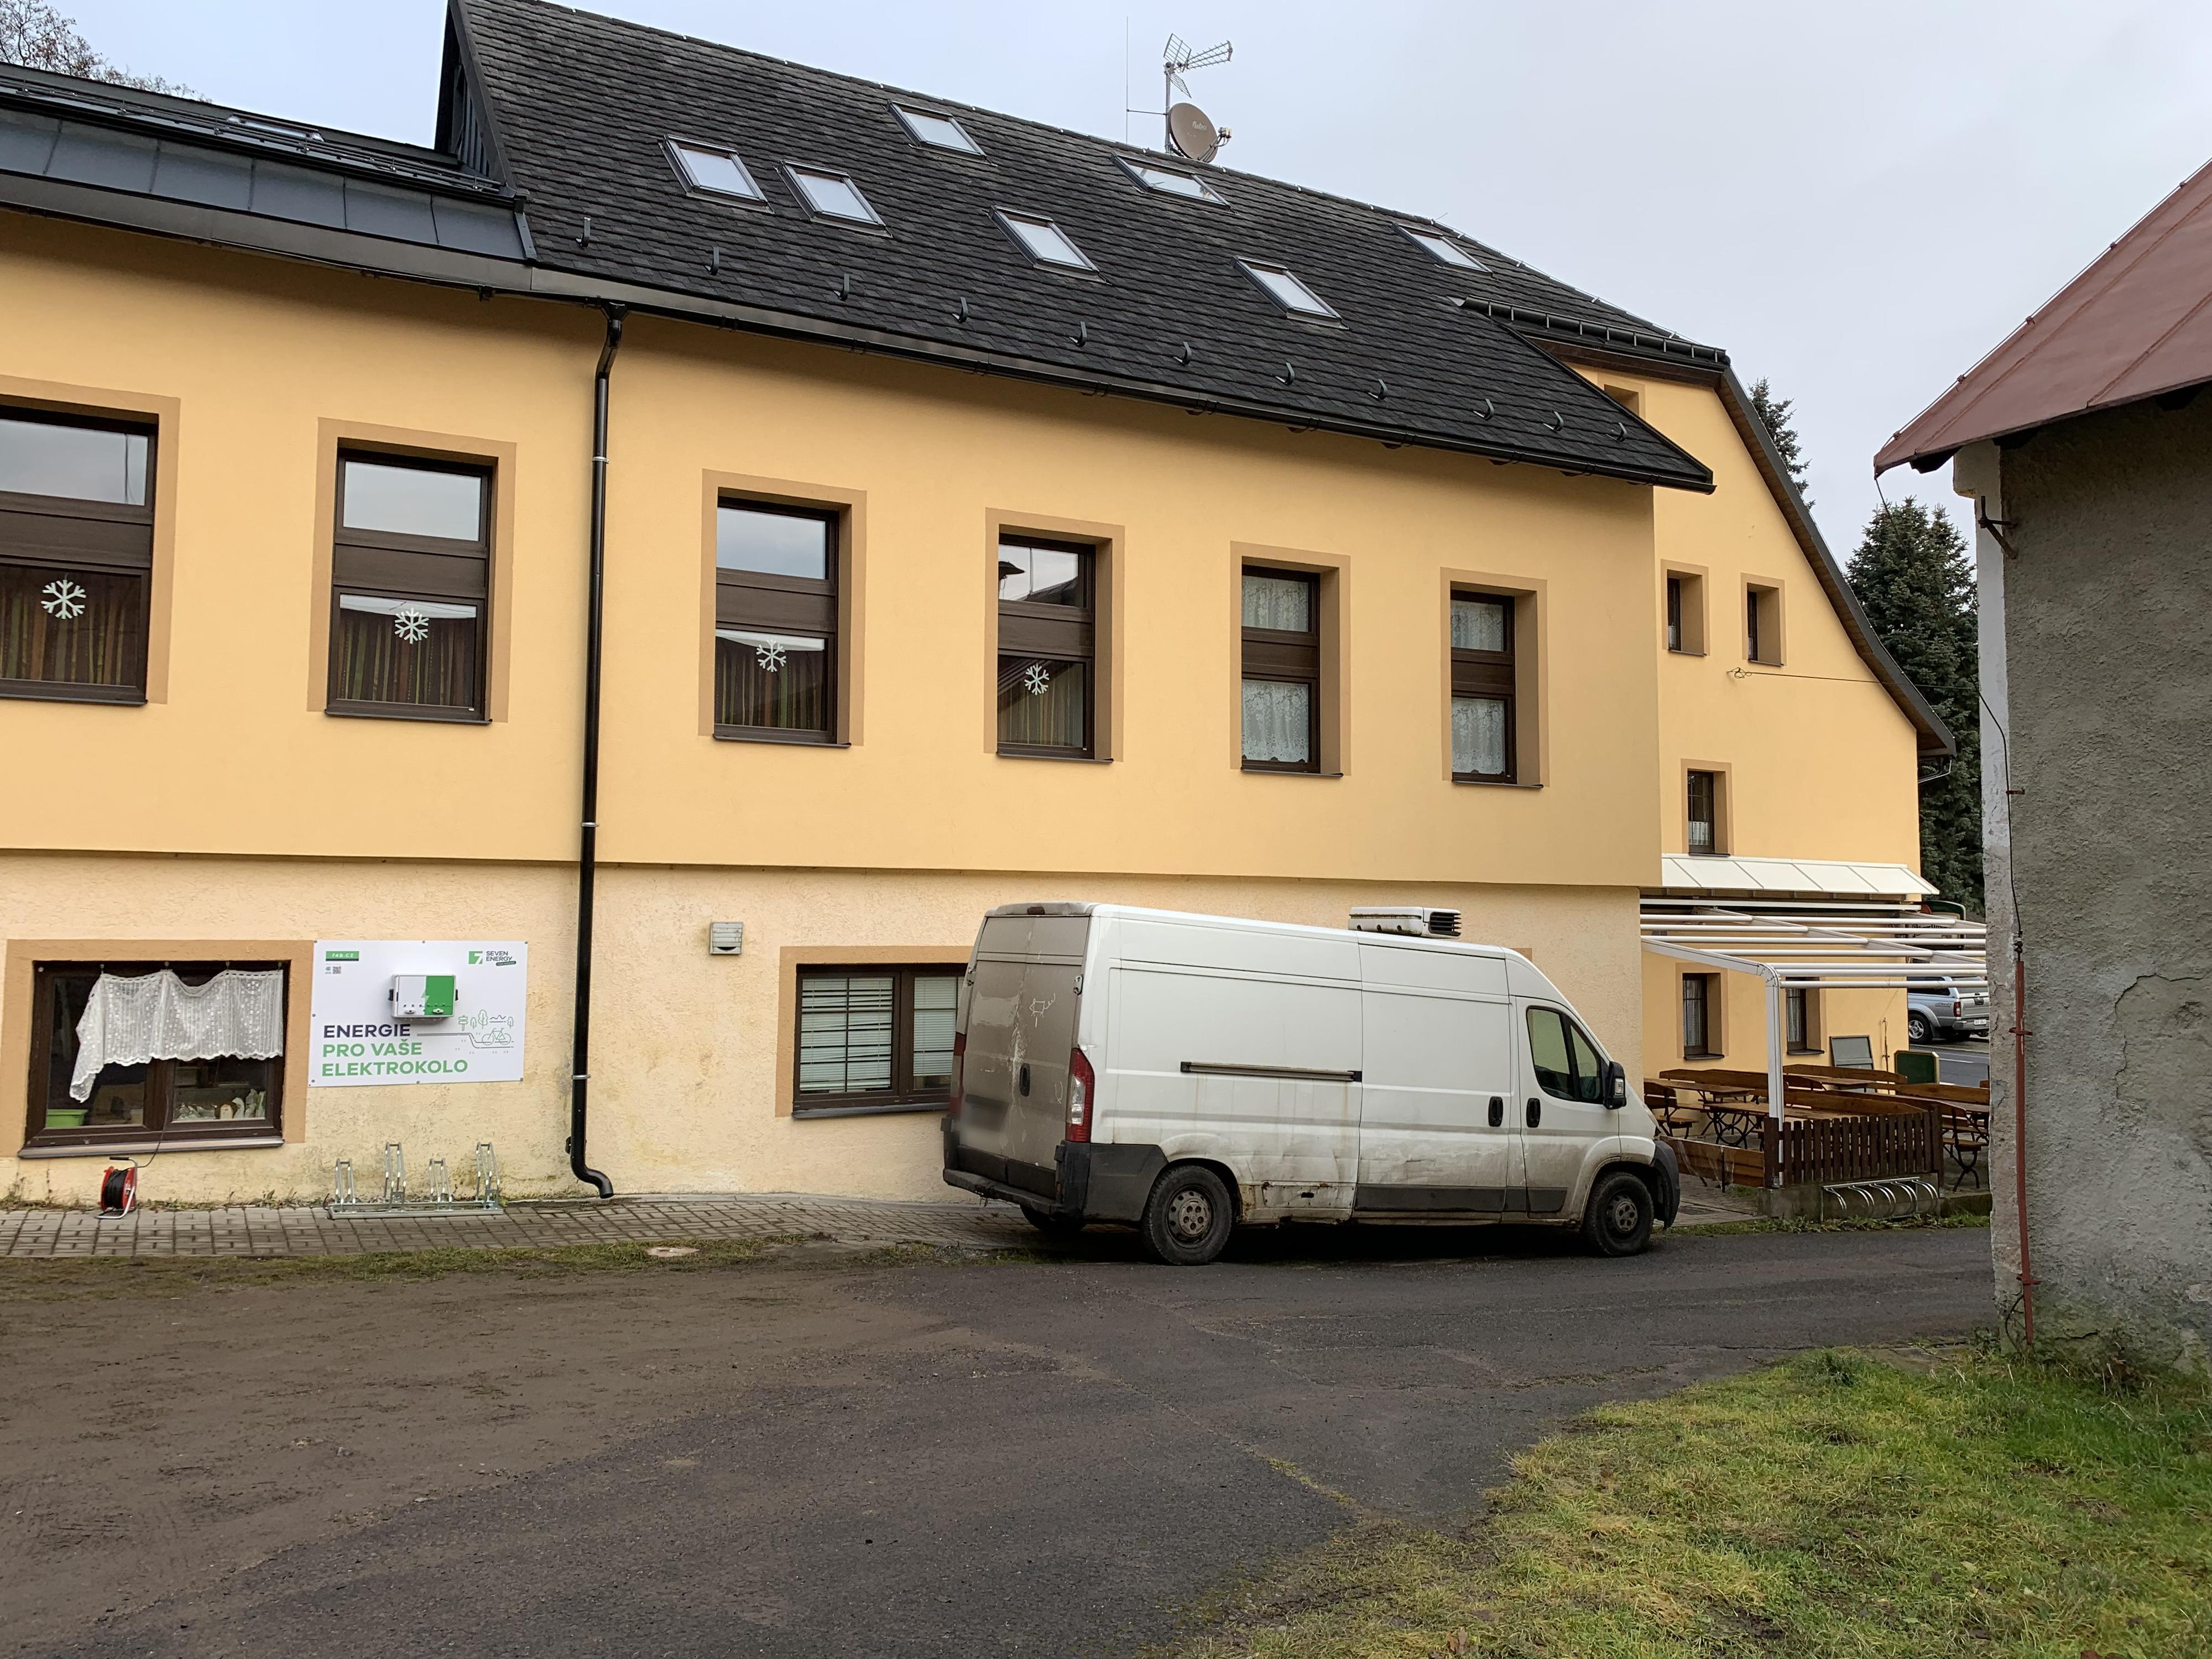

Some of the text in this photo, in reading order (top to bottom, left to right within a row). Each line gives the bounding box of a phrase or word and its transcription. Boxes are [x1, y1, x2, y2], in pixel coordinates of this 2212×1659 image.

[324, 1024, 411, 1038] ENERGIE
[322, 1039, 422, 1057] PRO VAŠE
[322, 1059, 468, 1077] ELEKTROKOLO
